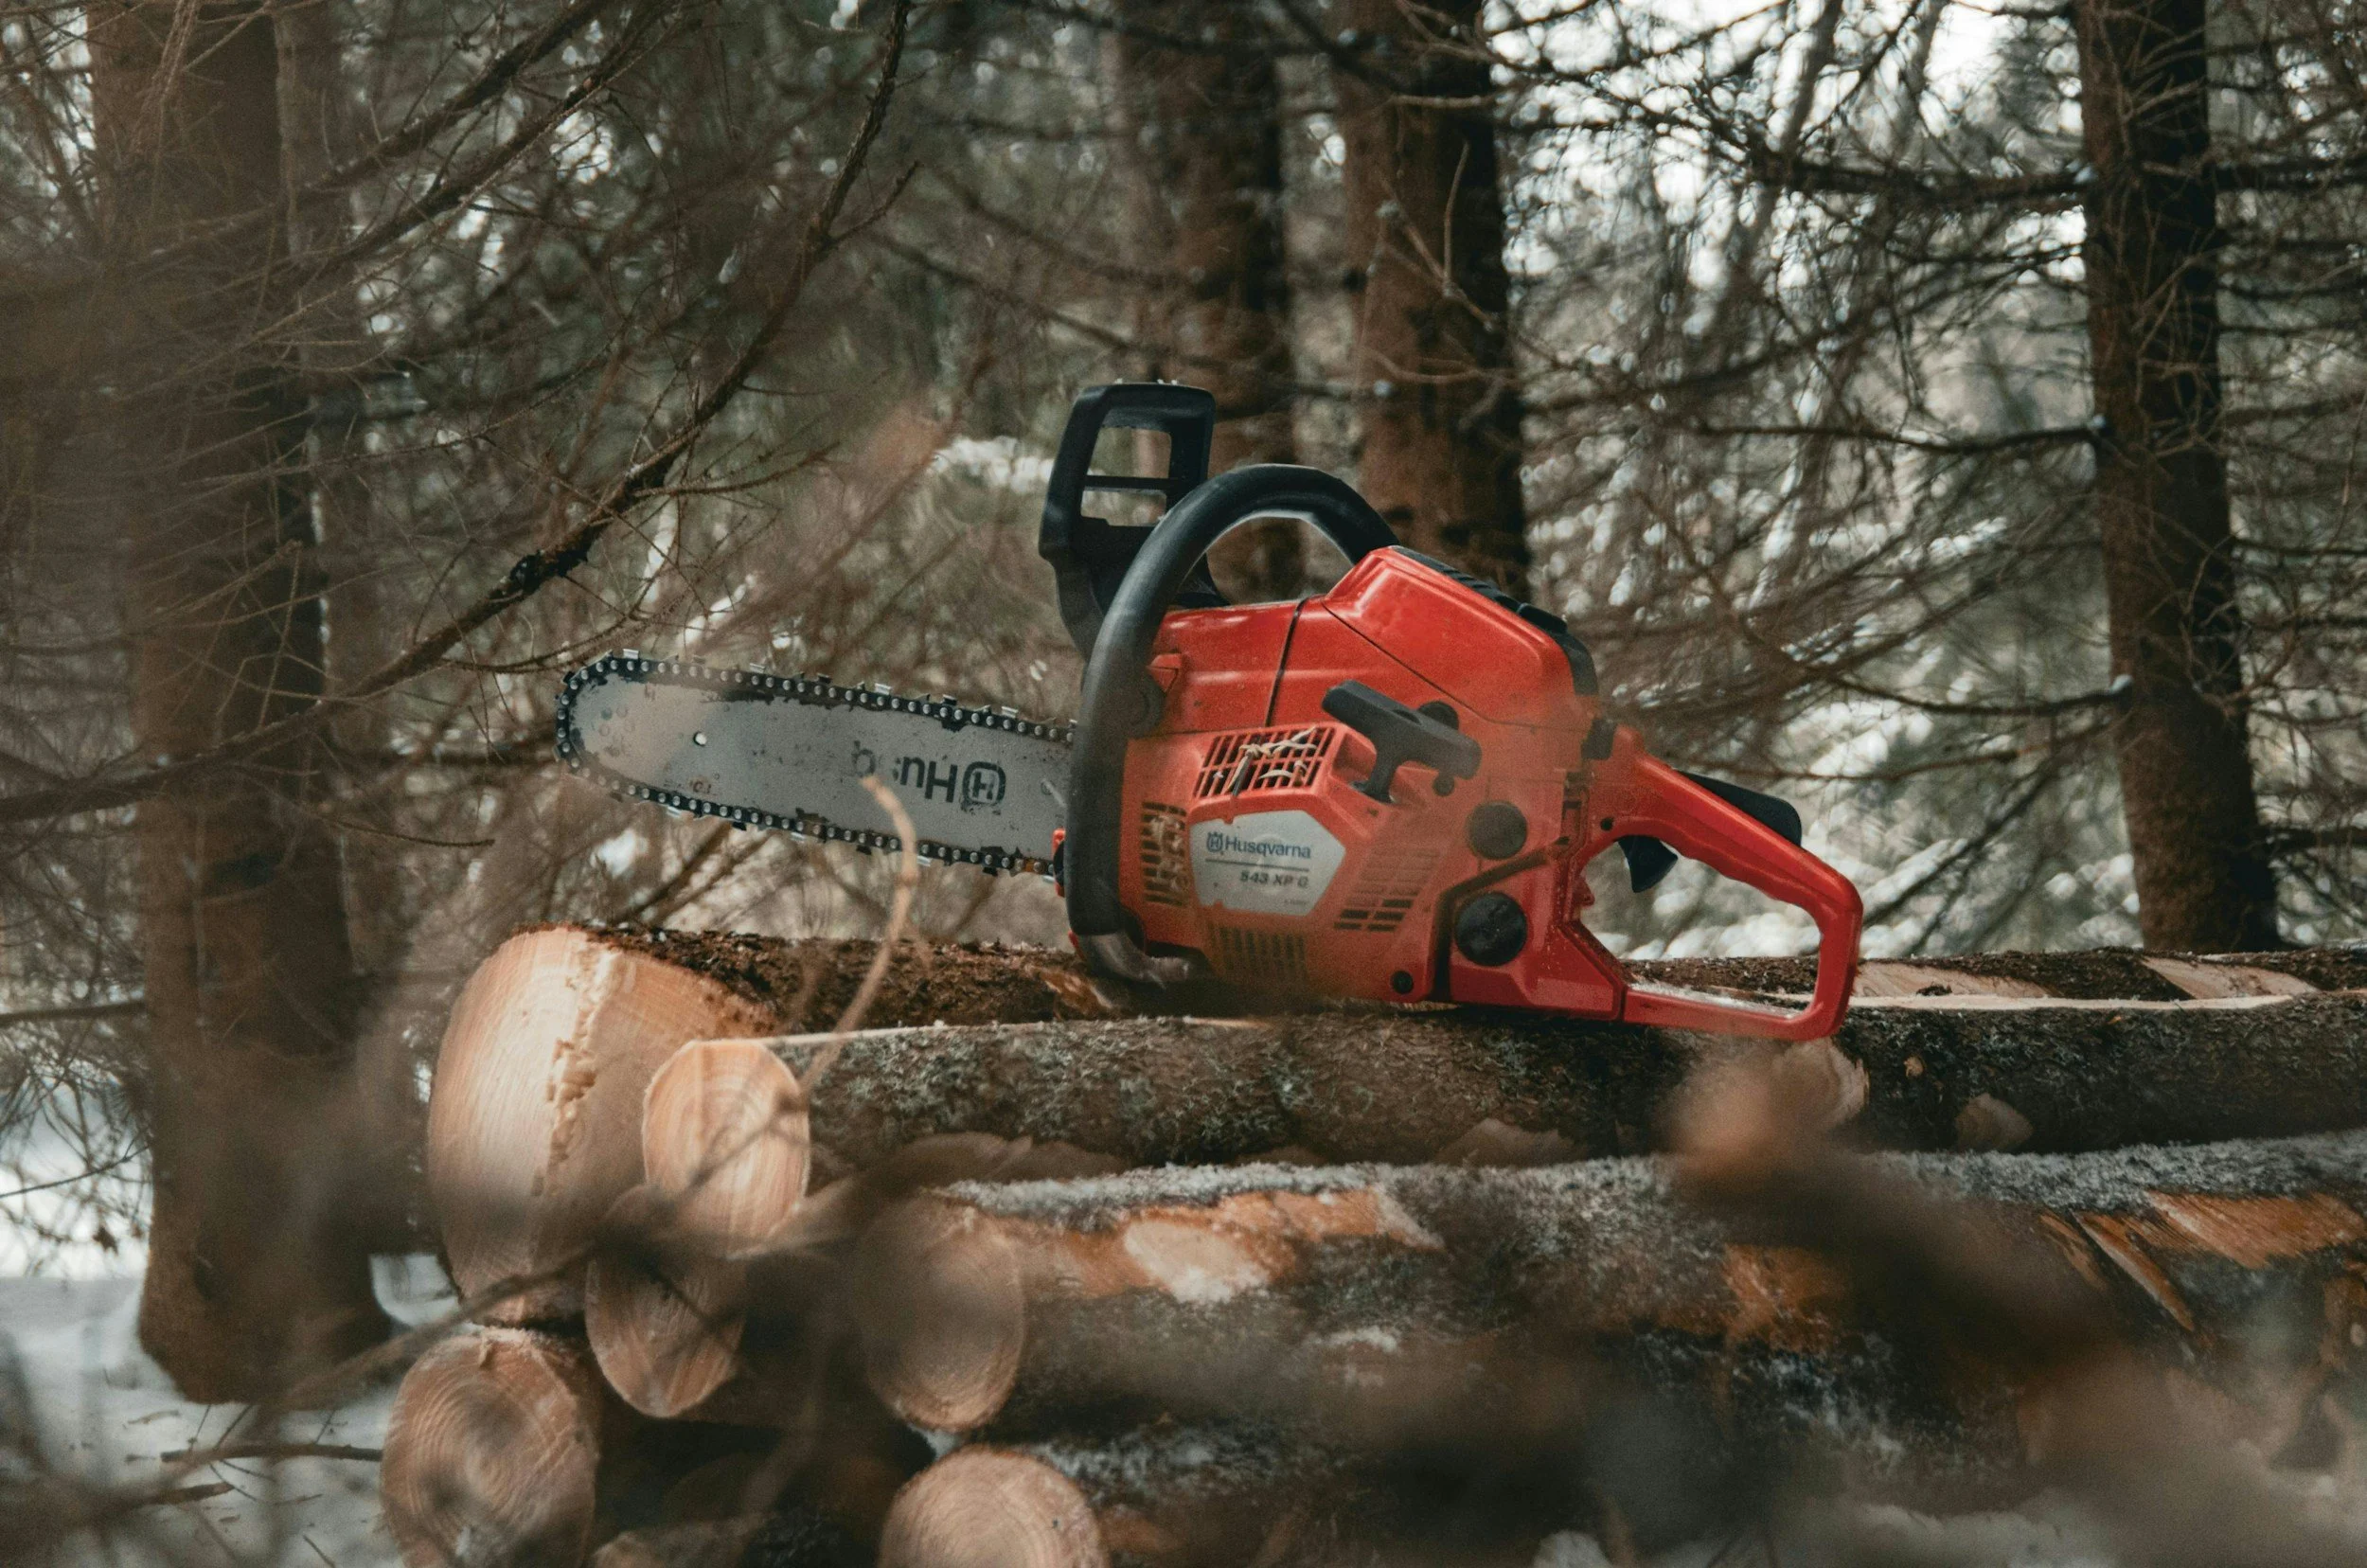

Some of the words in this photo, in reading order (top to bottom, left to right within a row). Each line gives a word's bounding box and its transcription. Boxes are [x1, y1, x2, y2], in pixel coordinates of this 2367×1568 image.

[1225, 835, 1311, 860] Husqvarna
[1239, 870, 1270, 885] 543
[1272, 873, 1294, 887] XP
